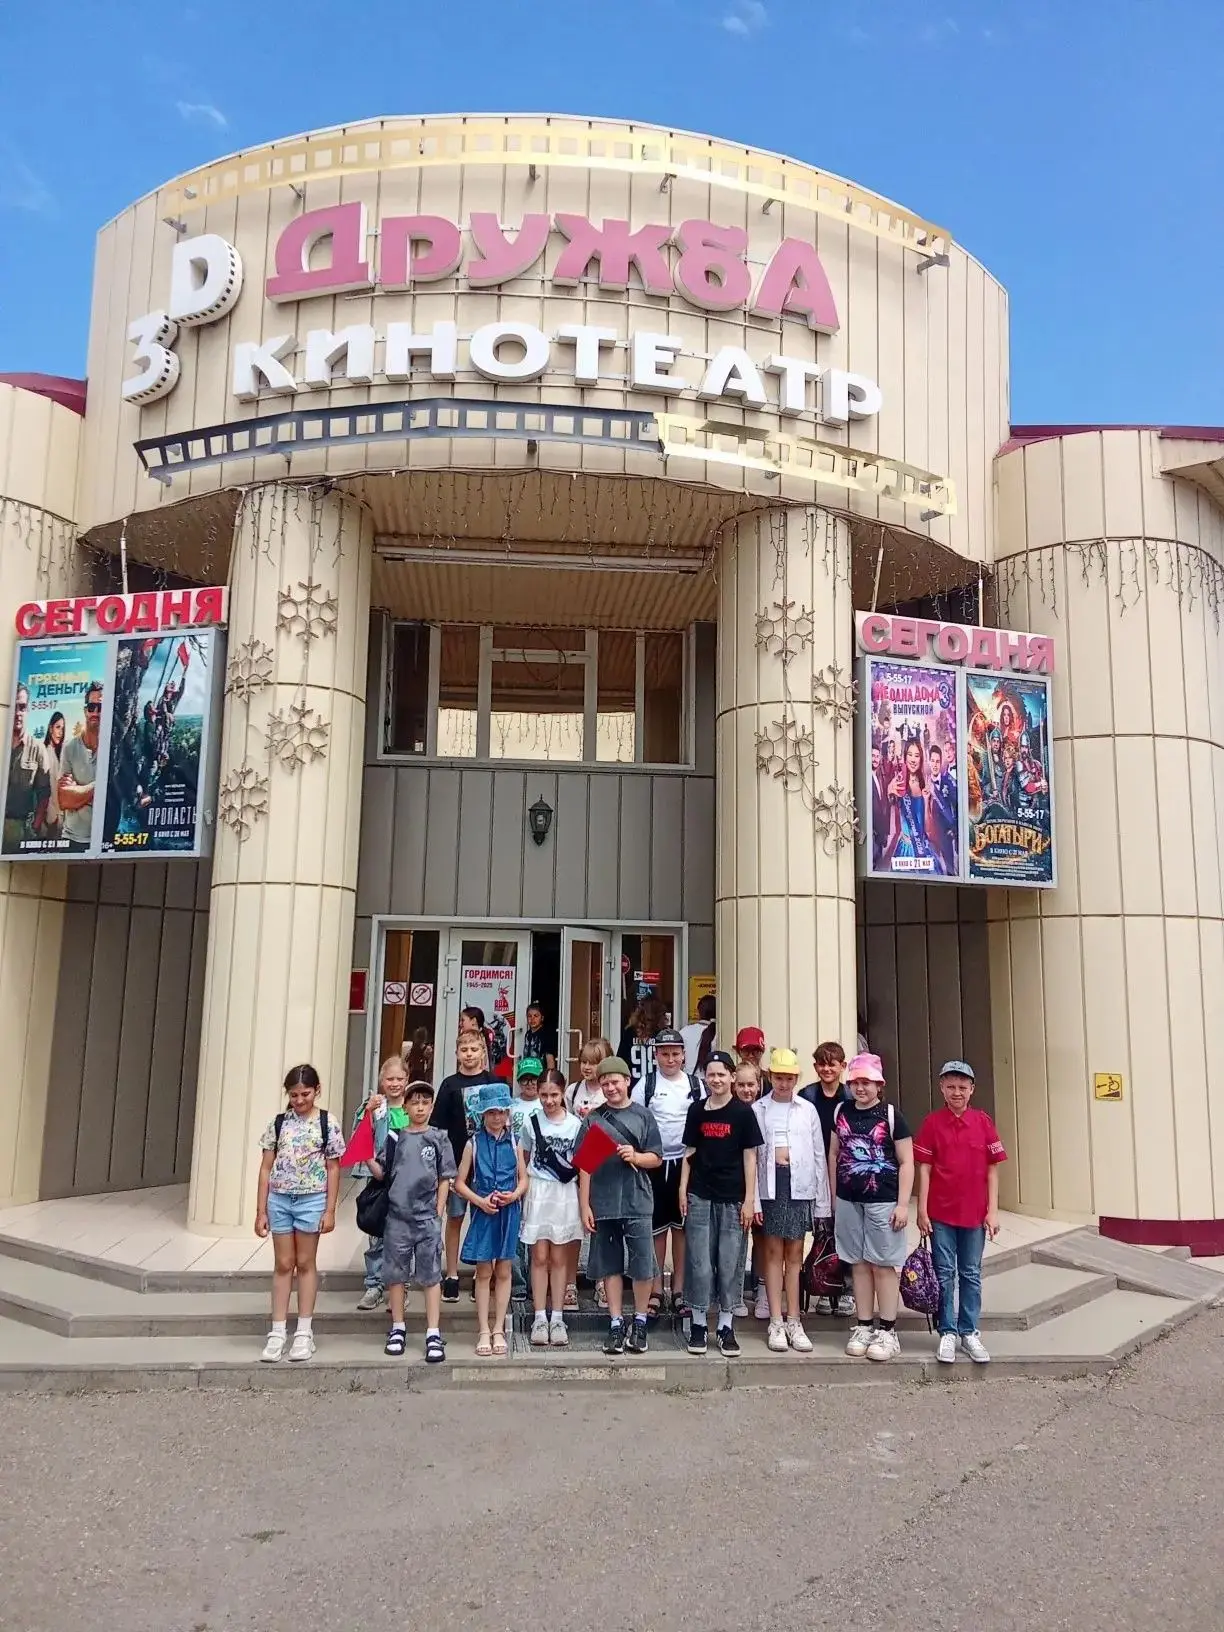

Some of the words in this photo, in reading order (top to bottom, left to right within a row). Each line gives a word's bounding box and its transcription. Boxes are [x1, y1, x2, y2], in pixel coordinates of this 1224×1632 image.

[232, 320, 883, 427] КИНОТЕАТР
[15, 587, 224, 638] СЕГОДНЯ
[861, 615, 1055, 674] СЕГОДНЯ
[886, 672, 913, 684] 5-55-17
[37, 681, 89, 698] ДЕНЬГИ
[914, 686, 940, 702] ДОМА
[31, 700, 59, 710] 5-55-17
[893, 703, 934, 715] ВЫПУСКНОЙ
[147, 806, 197, 826] ПРОПАСТЬ
[1017, 807, 1045, 819] 5-55-17
[113, 832, 150, 846] 5-55-17
[464, 969, 513, 980] ГОРДИМСЯ!
